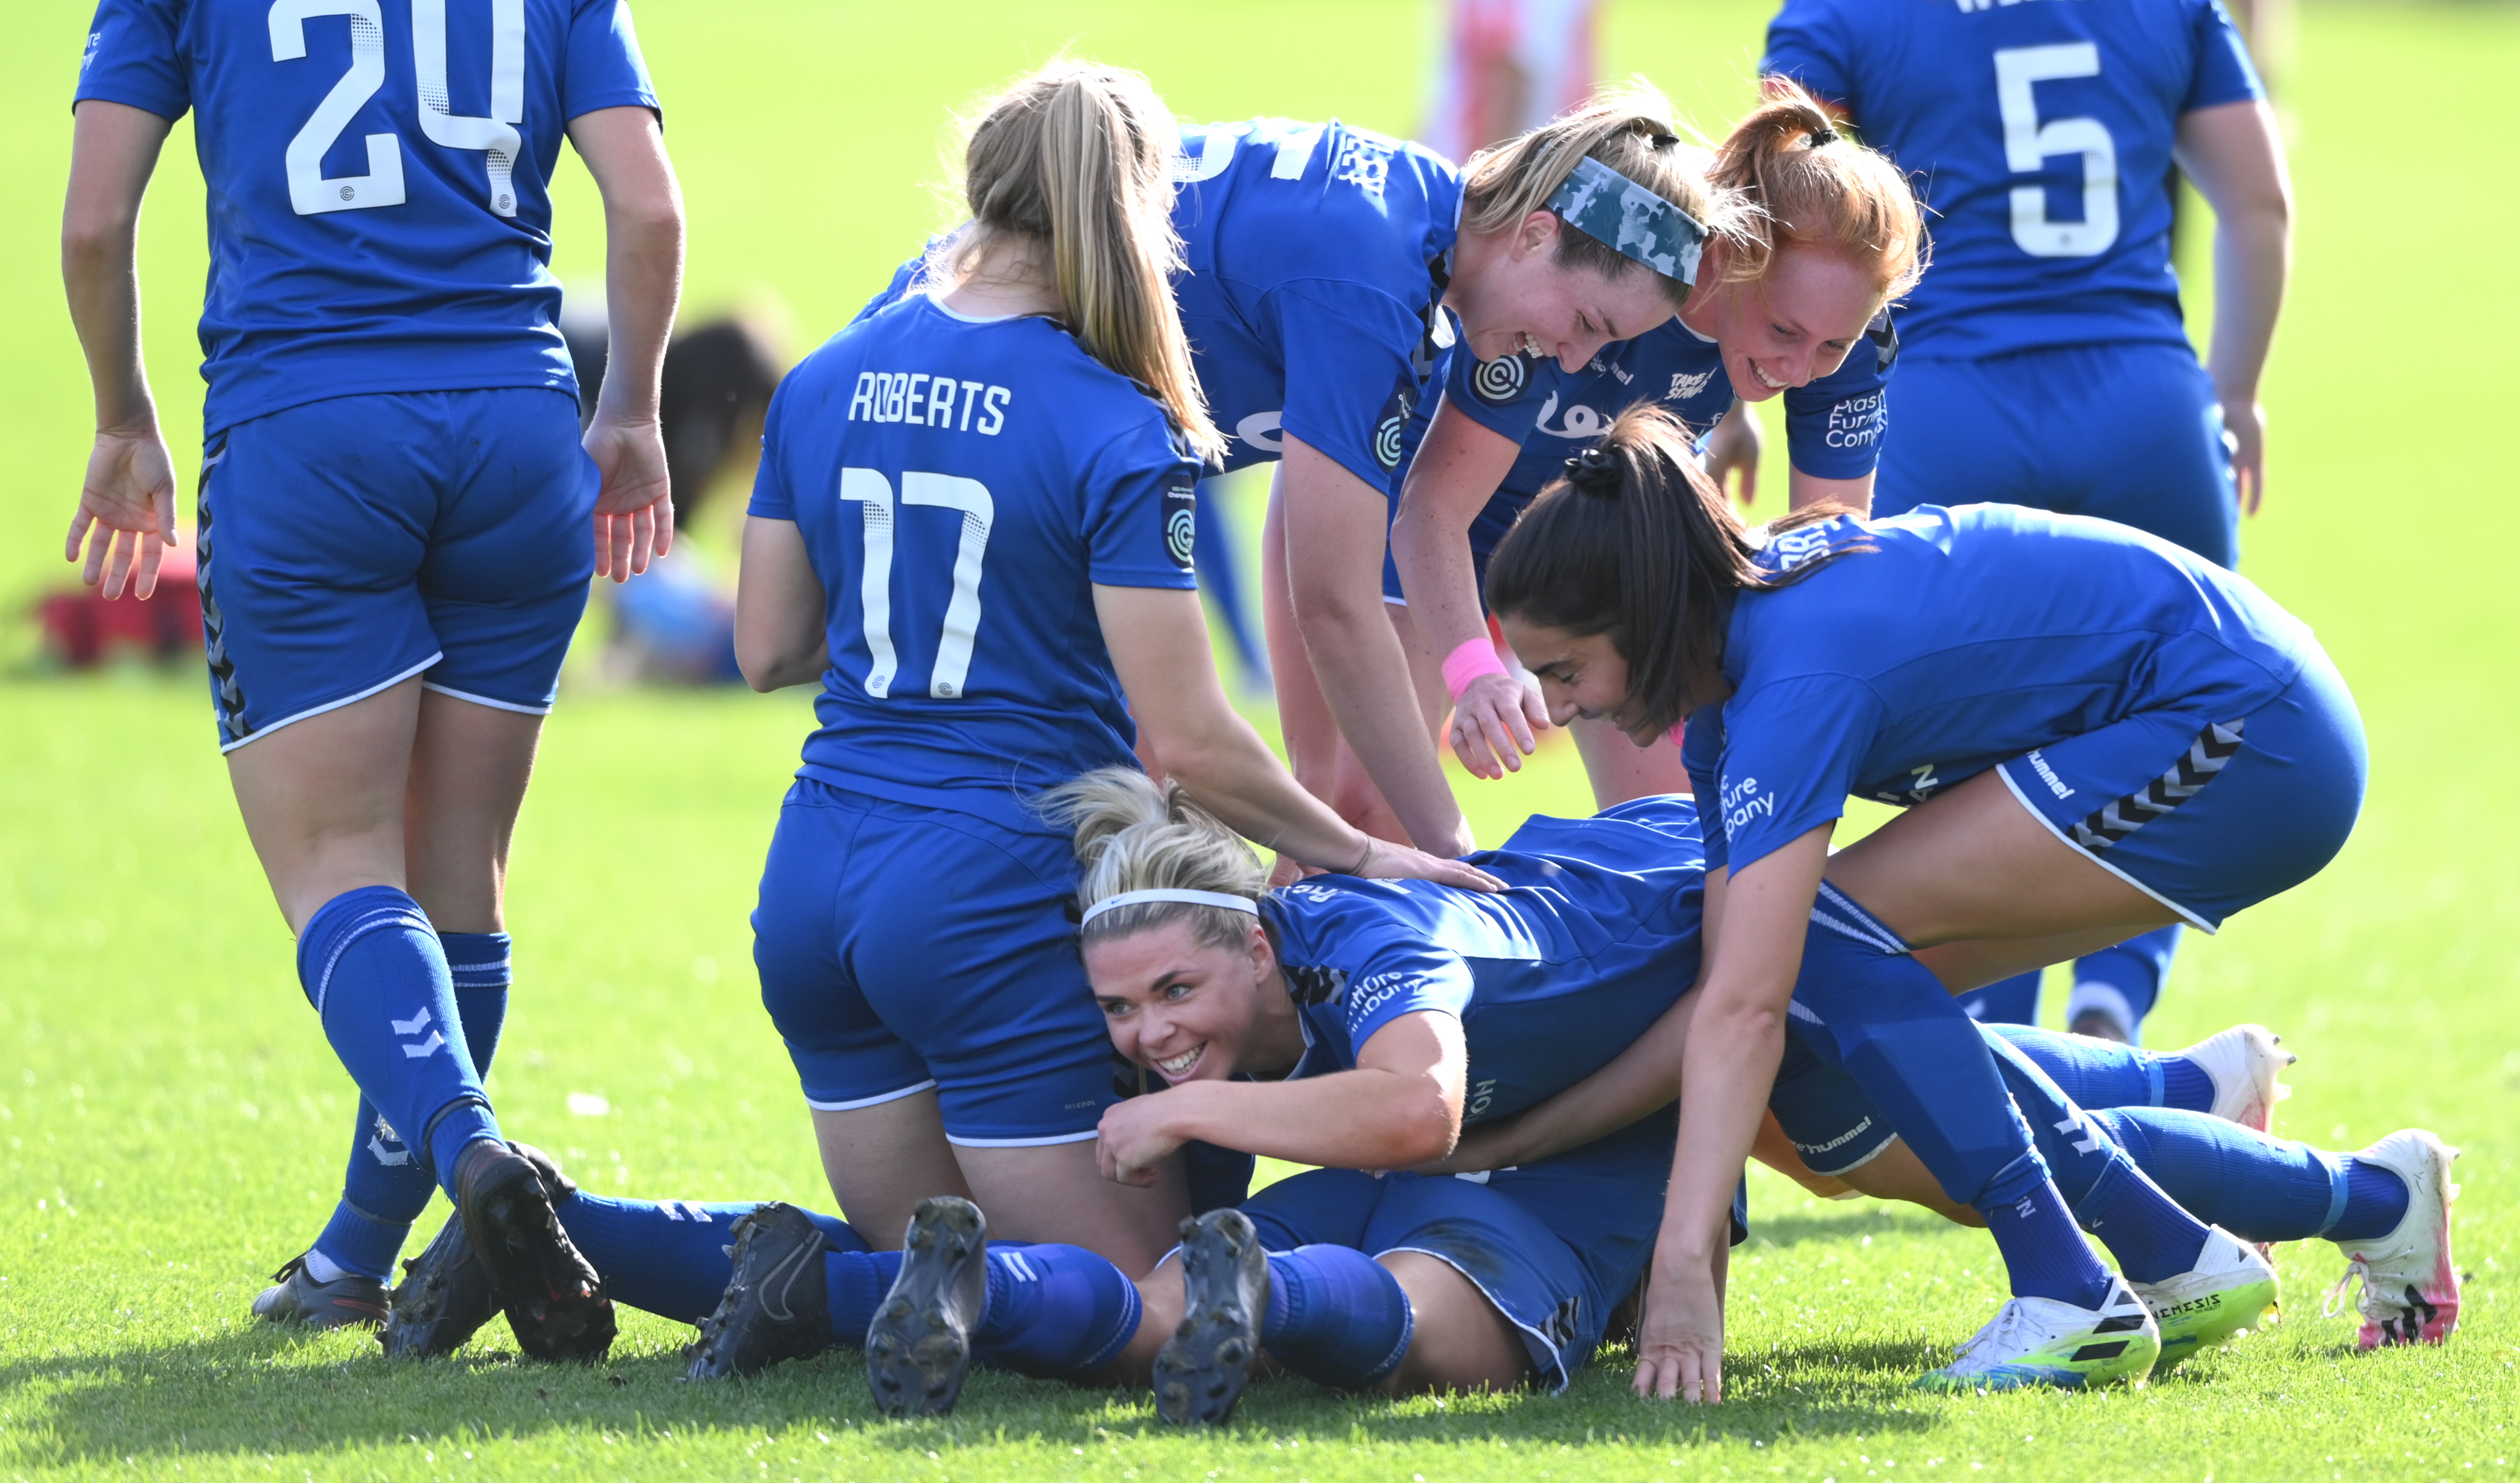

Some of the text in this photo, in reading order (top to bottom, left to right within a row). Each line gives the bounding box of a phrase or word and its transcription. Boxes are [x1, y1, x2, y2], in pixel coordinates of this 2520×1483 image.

[268, 0, 526, 217] 24
[1994, 42, 2119, 257] 5
[848, 372, 1011, 436] ROBERTS
[841, 467, 994, 699] 17
[1806, 1115, 1872, 1154] hummel
